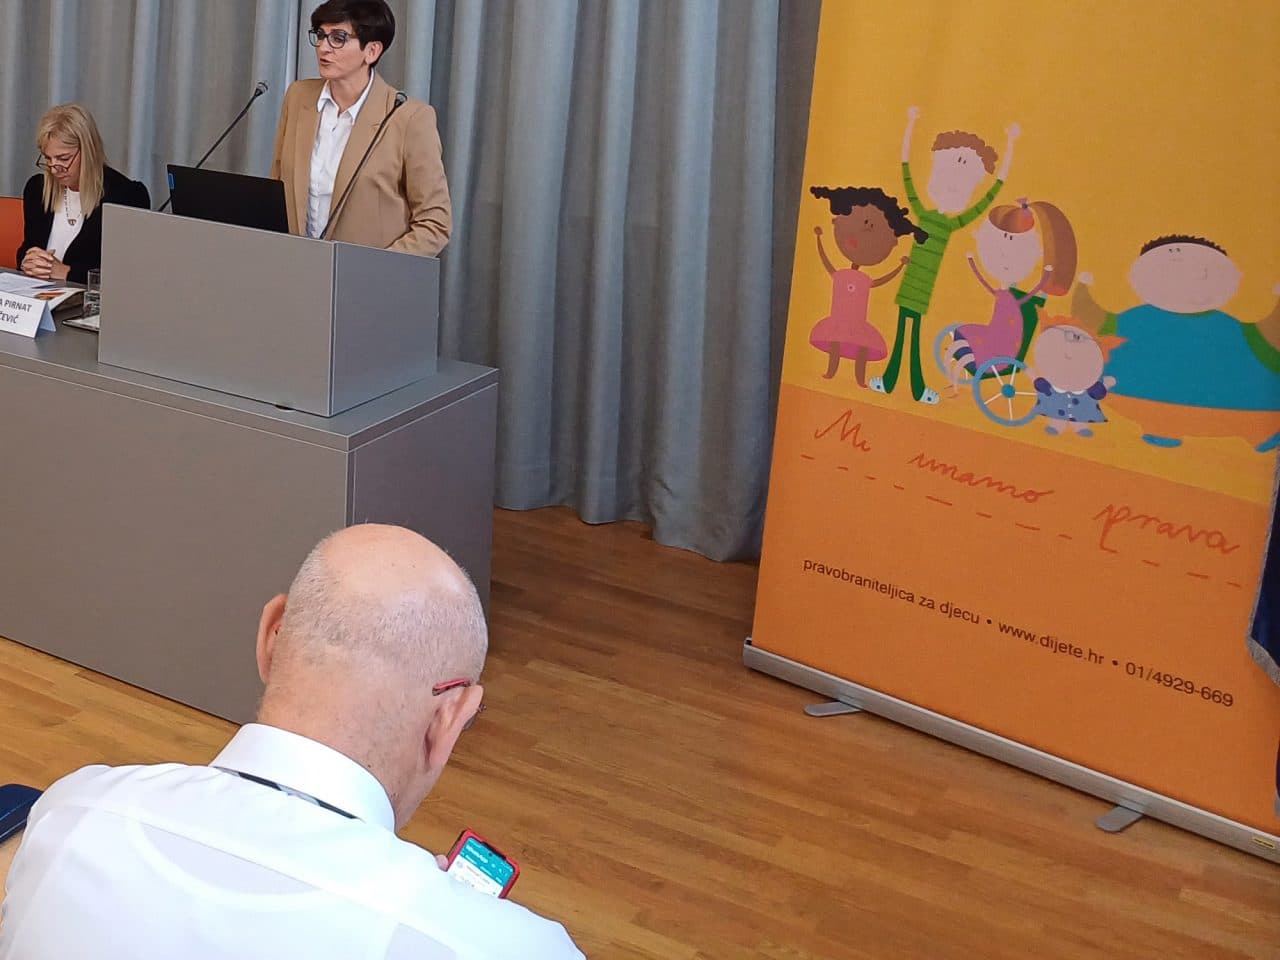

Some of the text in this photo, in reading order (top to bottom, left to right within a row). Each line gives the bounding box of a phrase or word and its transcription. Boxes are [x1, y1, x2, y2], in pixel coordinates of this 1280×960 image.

[4, 299, 32, 313] PIRNAT
[814, 409, 872, 452] Mi
[1092, 503, 1241, 554] prava
[803, 559, 1234, 708] pravobraniteljica za djecu www.dijete.hr 01/4929-669
